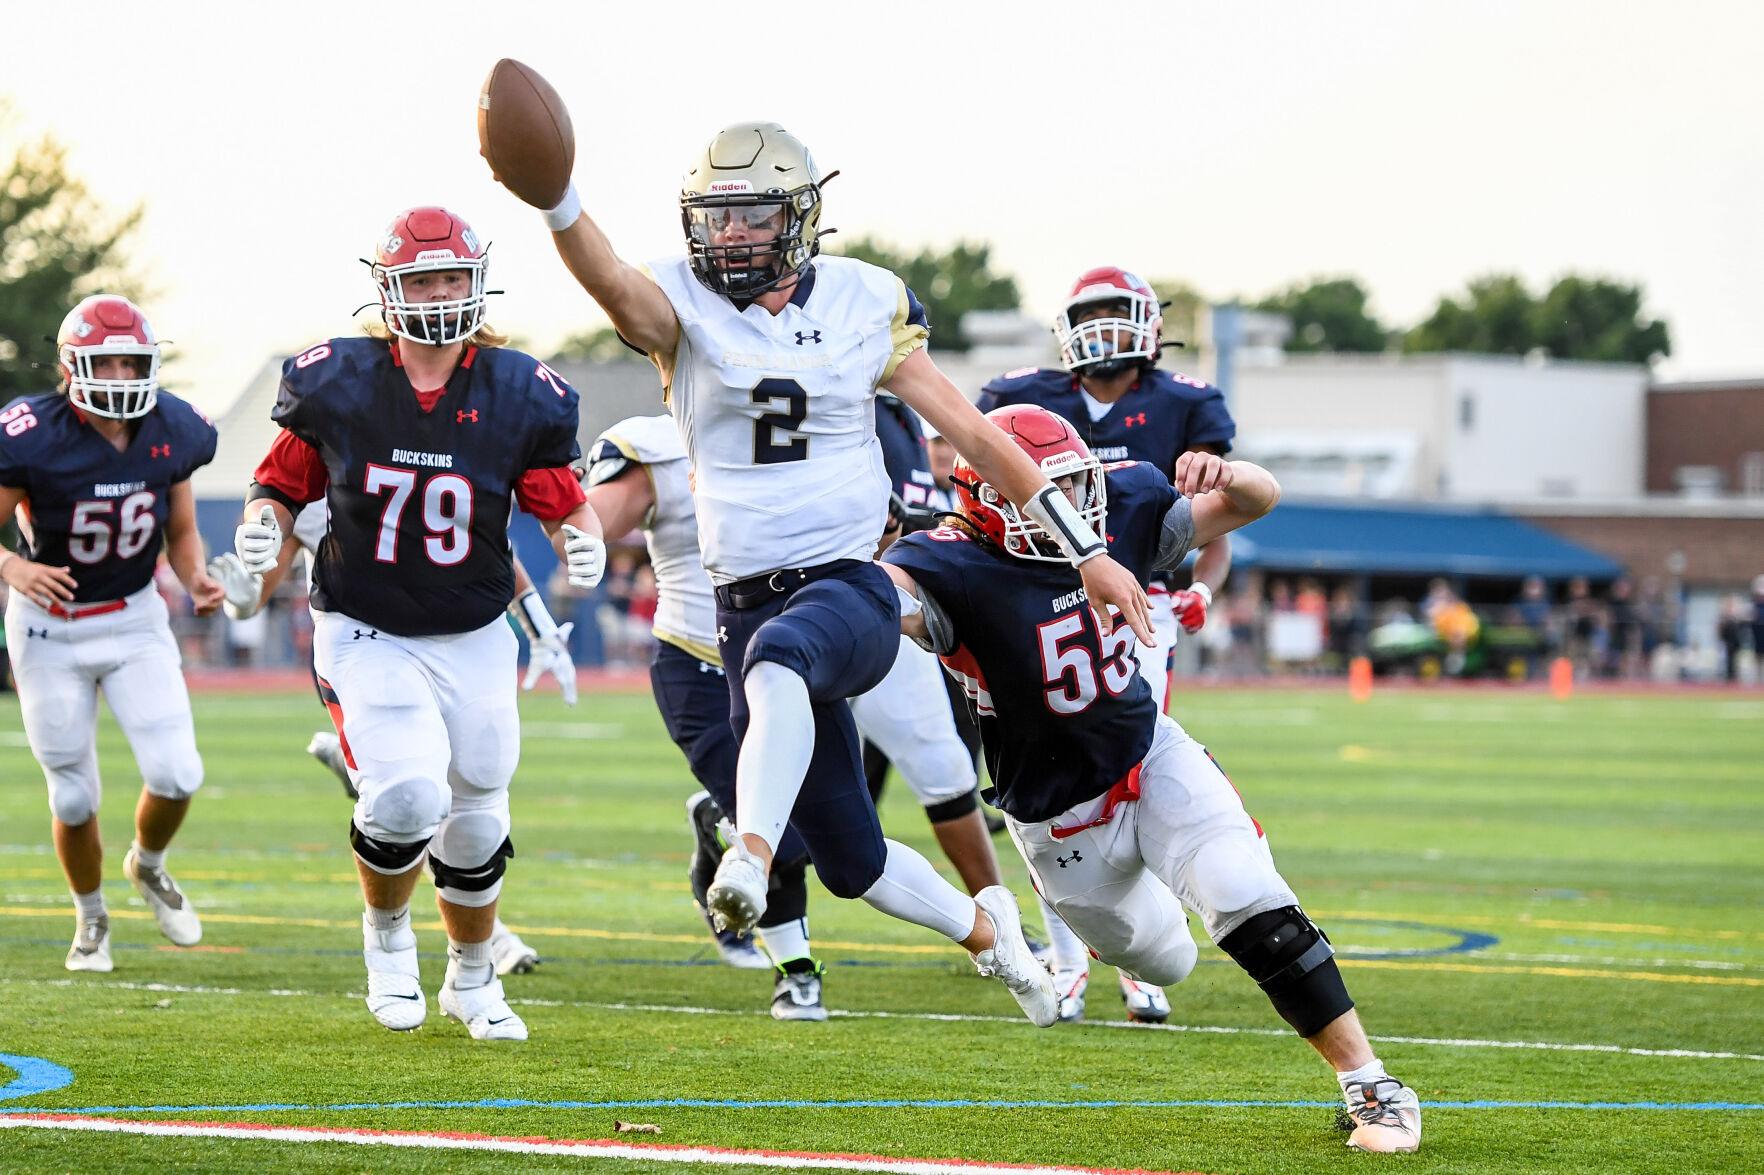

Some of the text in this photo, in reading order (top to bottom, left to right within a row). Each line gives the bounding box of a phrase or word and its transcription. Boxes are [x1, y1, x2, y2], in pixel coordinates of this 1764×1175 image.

[391, 448, 454, 468] BUCKSKINS
[748, 374, 811, 466] 2
[68, 499, 157, 565] 56
[363, 462, 475, 567] 79
[1051, 587, 1088, 614] BUCKS
[1036, 603, 1136, 715] 55
